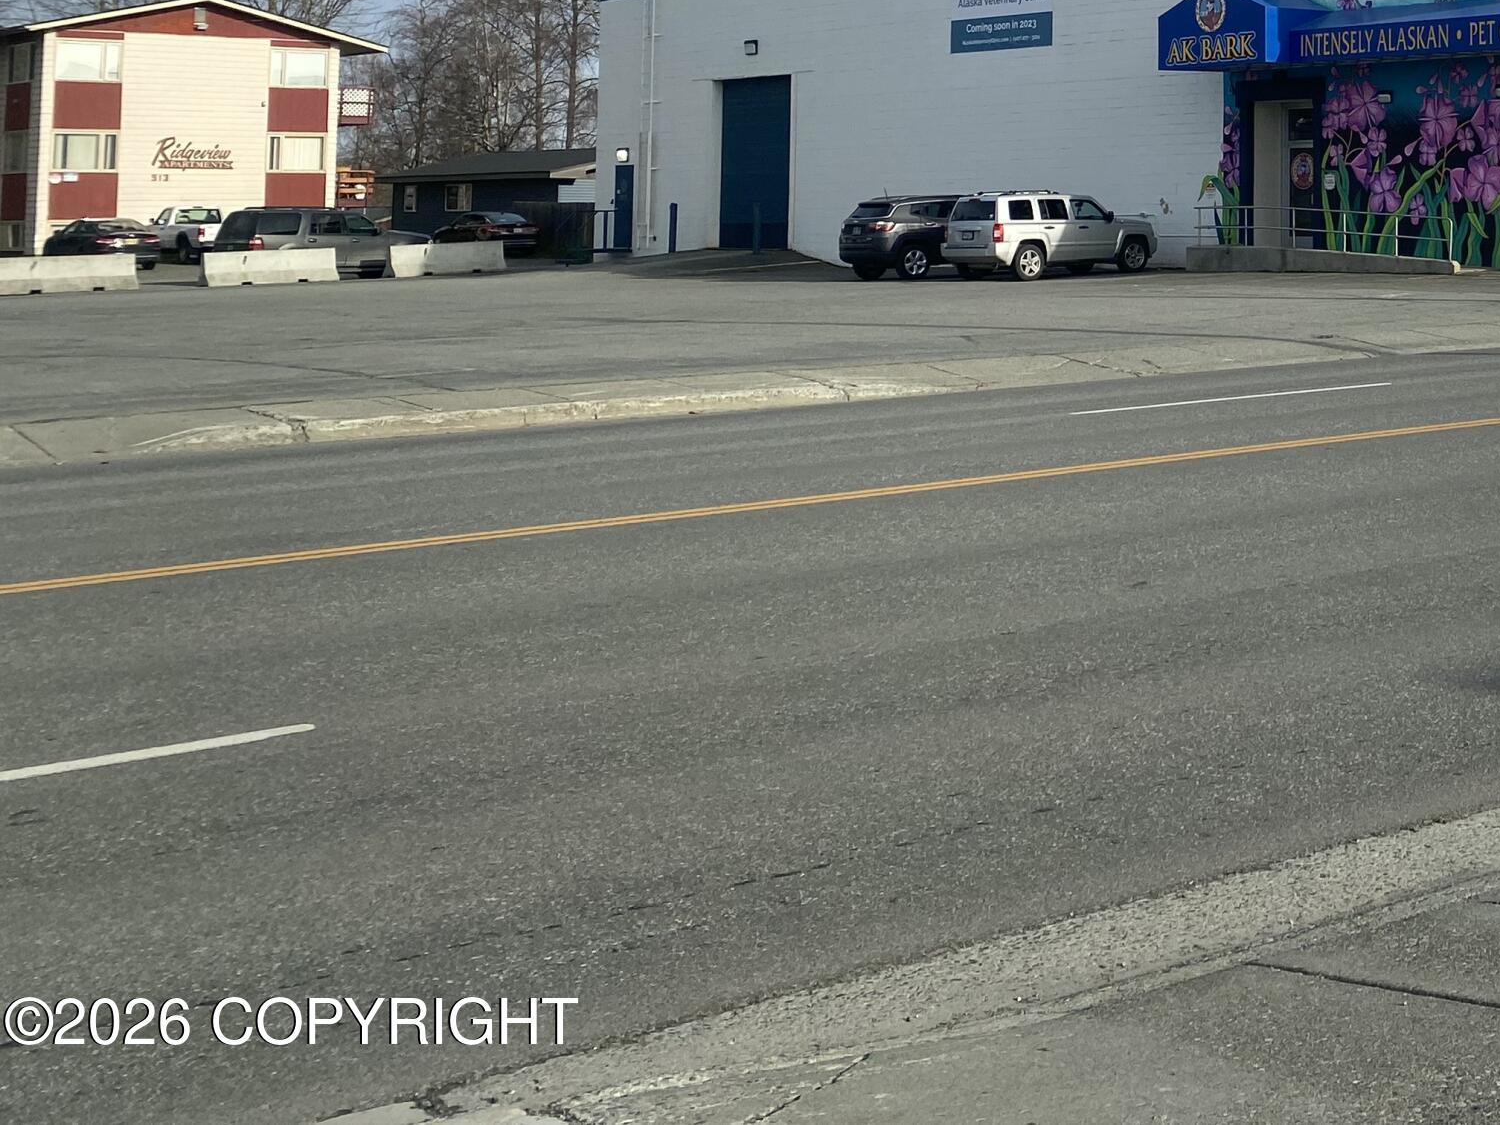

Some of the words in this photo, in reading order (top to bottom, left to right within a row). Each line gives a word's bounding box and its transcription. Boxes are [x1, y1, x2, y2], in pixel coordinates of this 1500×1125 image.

[966, 23, 993, 34] Coming
[994, 22, 1011, 31] soon
[1012, 20, 1018, 29] in
[1019, 19, 1037, 29] 2023
[1300, 29, 1373, 57] INTENSELY
[1376, 23, 1449, 51] ALASKAN
[1469, 19, 1495, 46] PET
[1167, 37, 1197, 65] AK
[1199, 31, 1257, 62] BARK
[151, 136, 232, 172] Ridgeview
[161, 160, 231, 169] APARTMENTS
